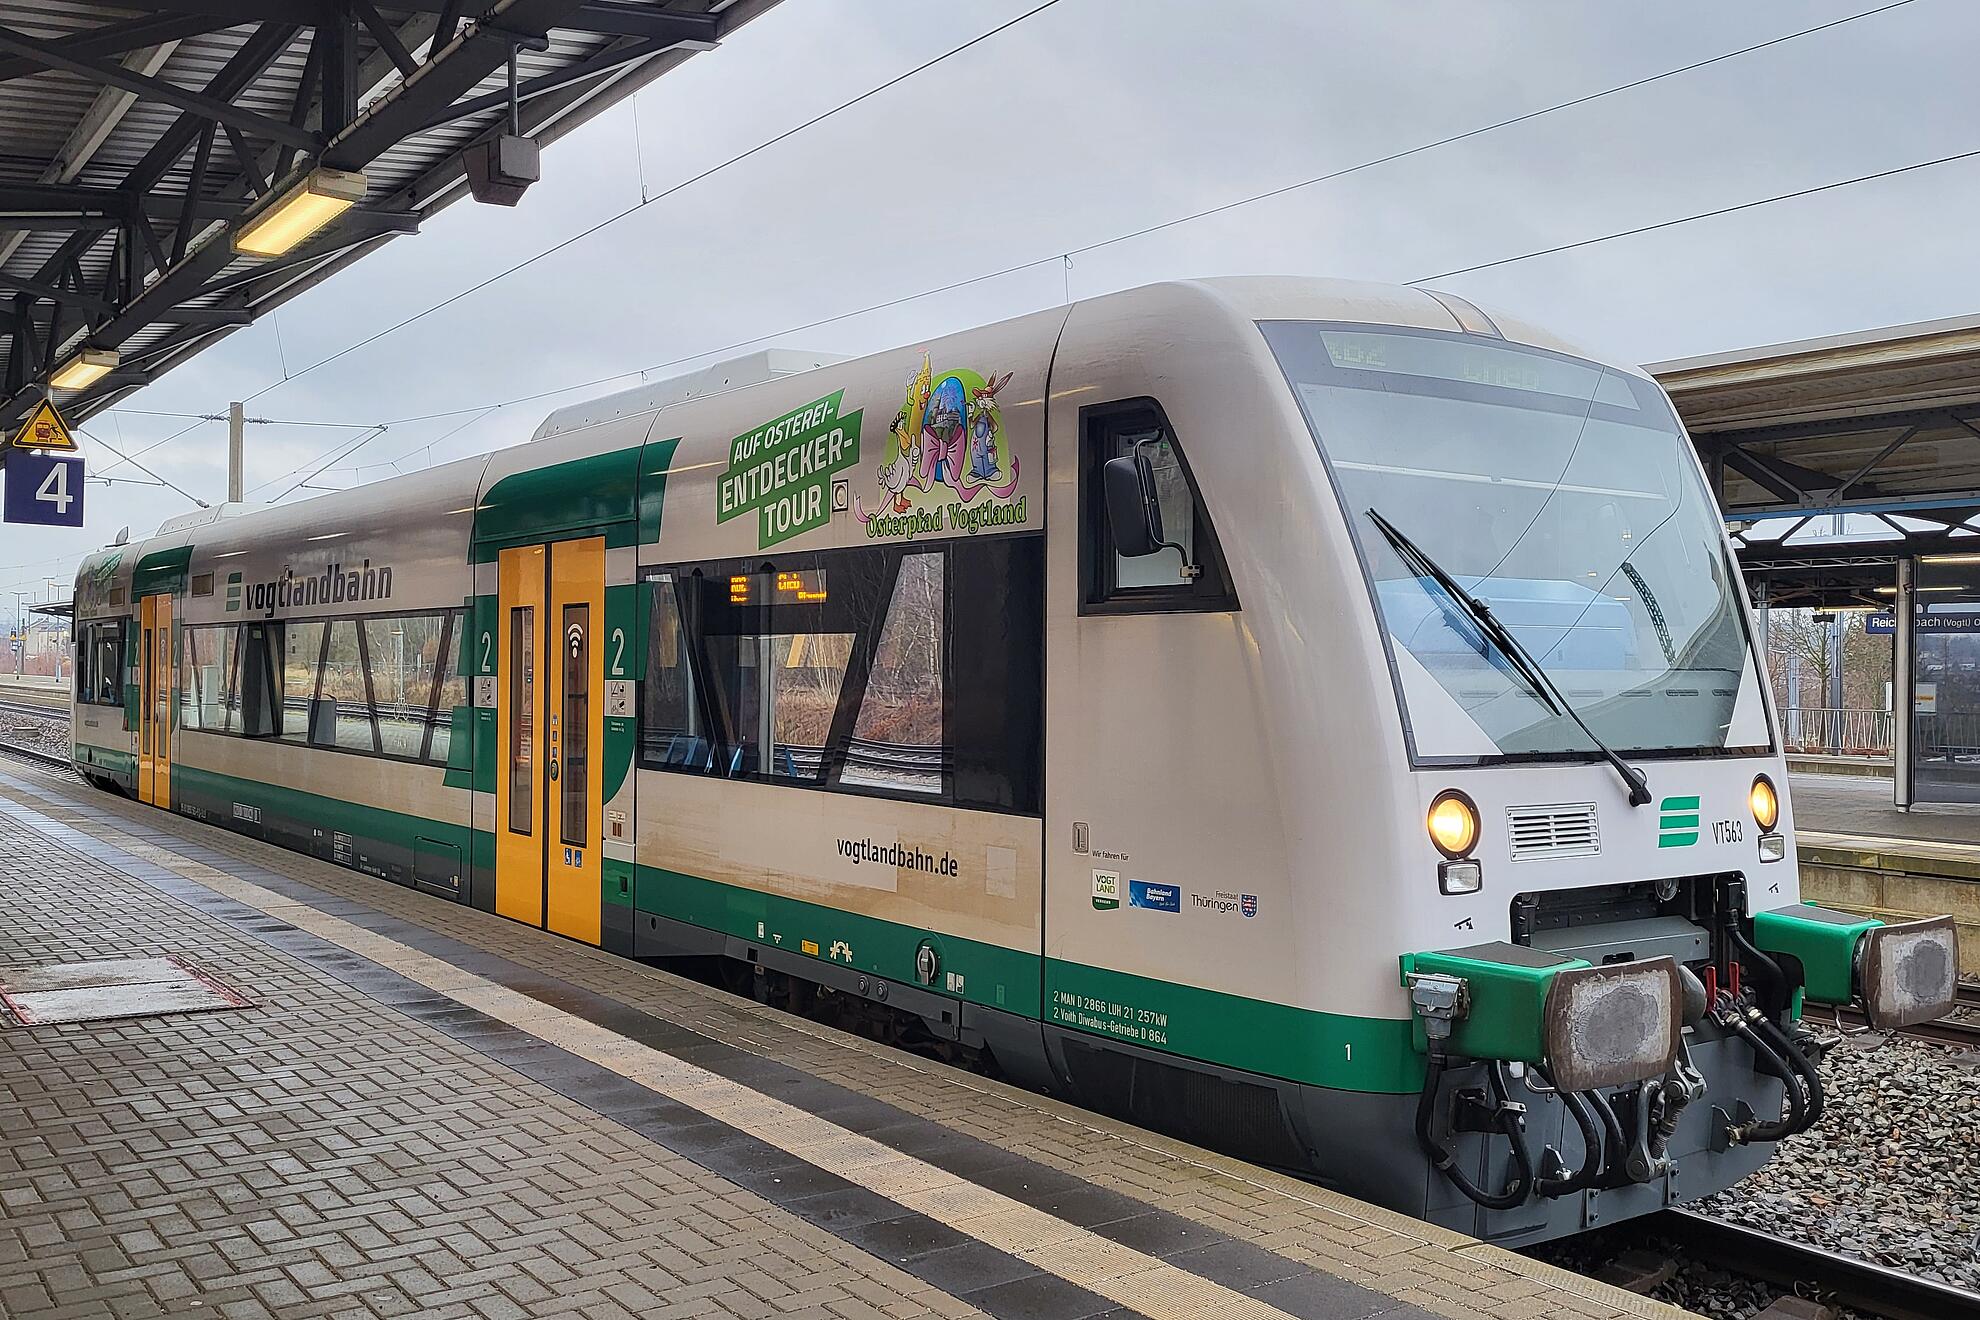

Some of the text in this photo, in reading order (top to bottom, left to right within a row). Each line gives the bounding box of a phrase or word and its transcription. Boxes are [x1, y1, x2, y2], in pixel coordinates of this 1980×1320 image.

[734, 400, 834, 465] AUF OSTEREI-
[35, 462, 73, 514] 4
[722, 427, 853, 513] ENTDECKER-
[764, 484, 822, 538] TOUR
[866, 496, 1027, 540] Osterpfad Vogtland
[246, 559, 393, 618] vogtlandbahn
[1871, 616, 1941, 628] Reicach
[1943, 617, 1971, 629] (Vogtl)
[481, 631, 491, 673] 2
[611, 627, 624, 676] 2
[1711, 820, 1743, 845] VT563
[836, 837, 958, 877] vogtlandbahn.de
[1092, 850, 1129, 861] Wir fahren für
[1096, 874, 1116, 886] VOGT
[1096, 884, 1116, 894] LAND
[1145, 893, 1165, 902] Bayern
[1215, 890, 1239, 901] Freistaat
[1191, 894, 1239, 914] Thüringen
[1053, 990, 1168, 1027] 2 MAN D 2866 LUH 21 257kW
[1053, 1007, 1167, 1045] 2 Voith Diwabus-Getriebe D 864
[1344, 1043, 1351, 1061] 1
